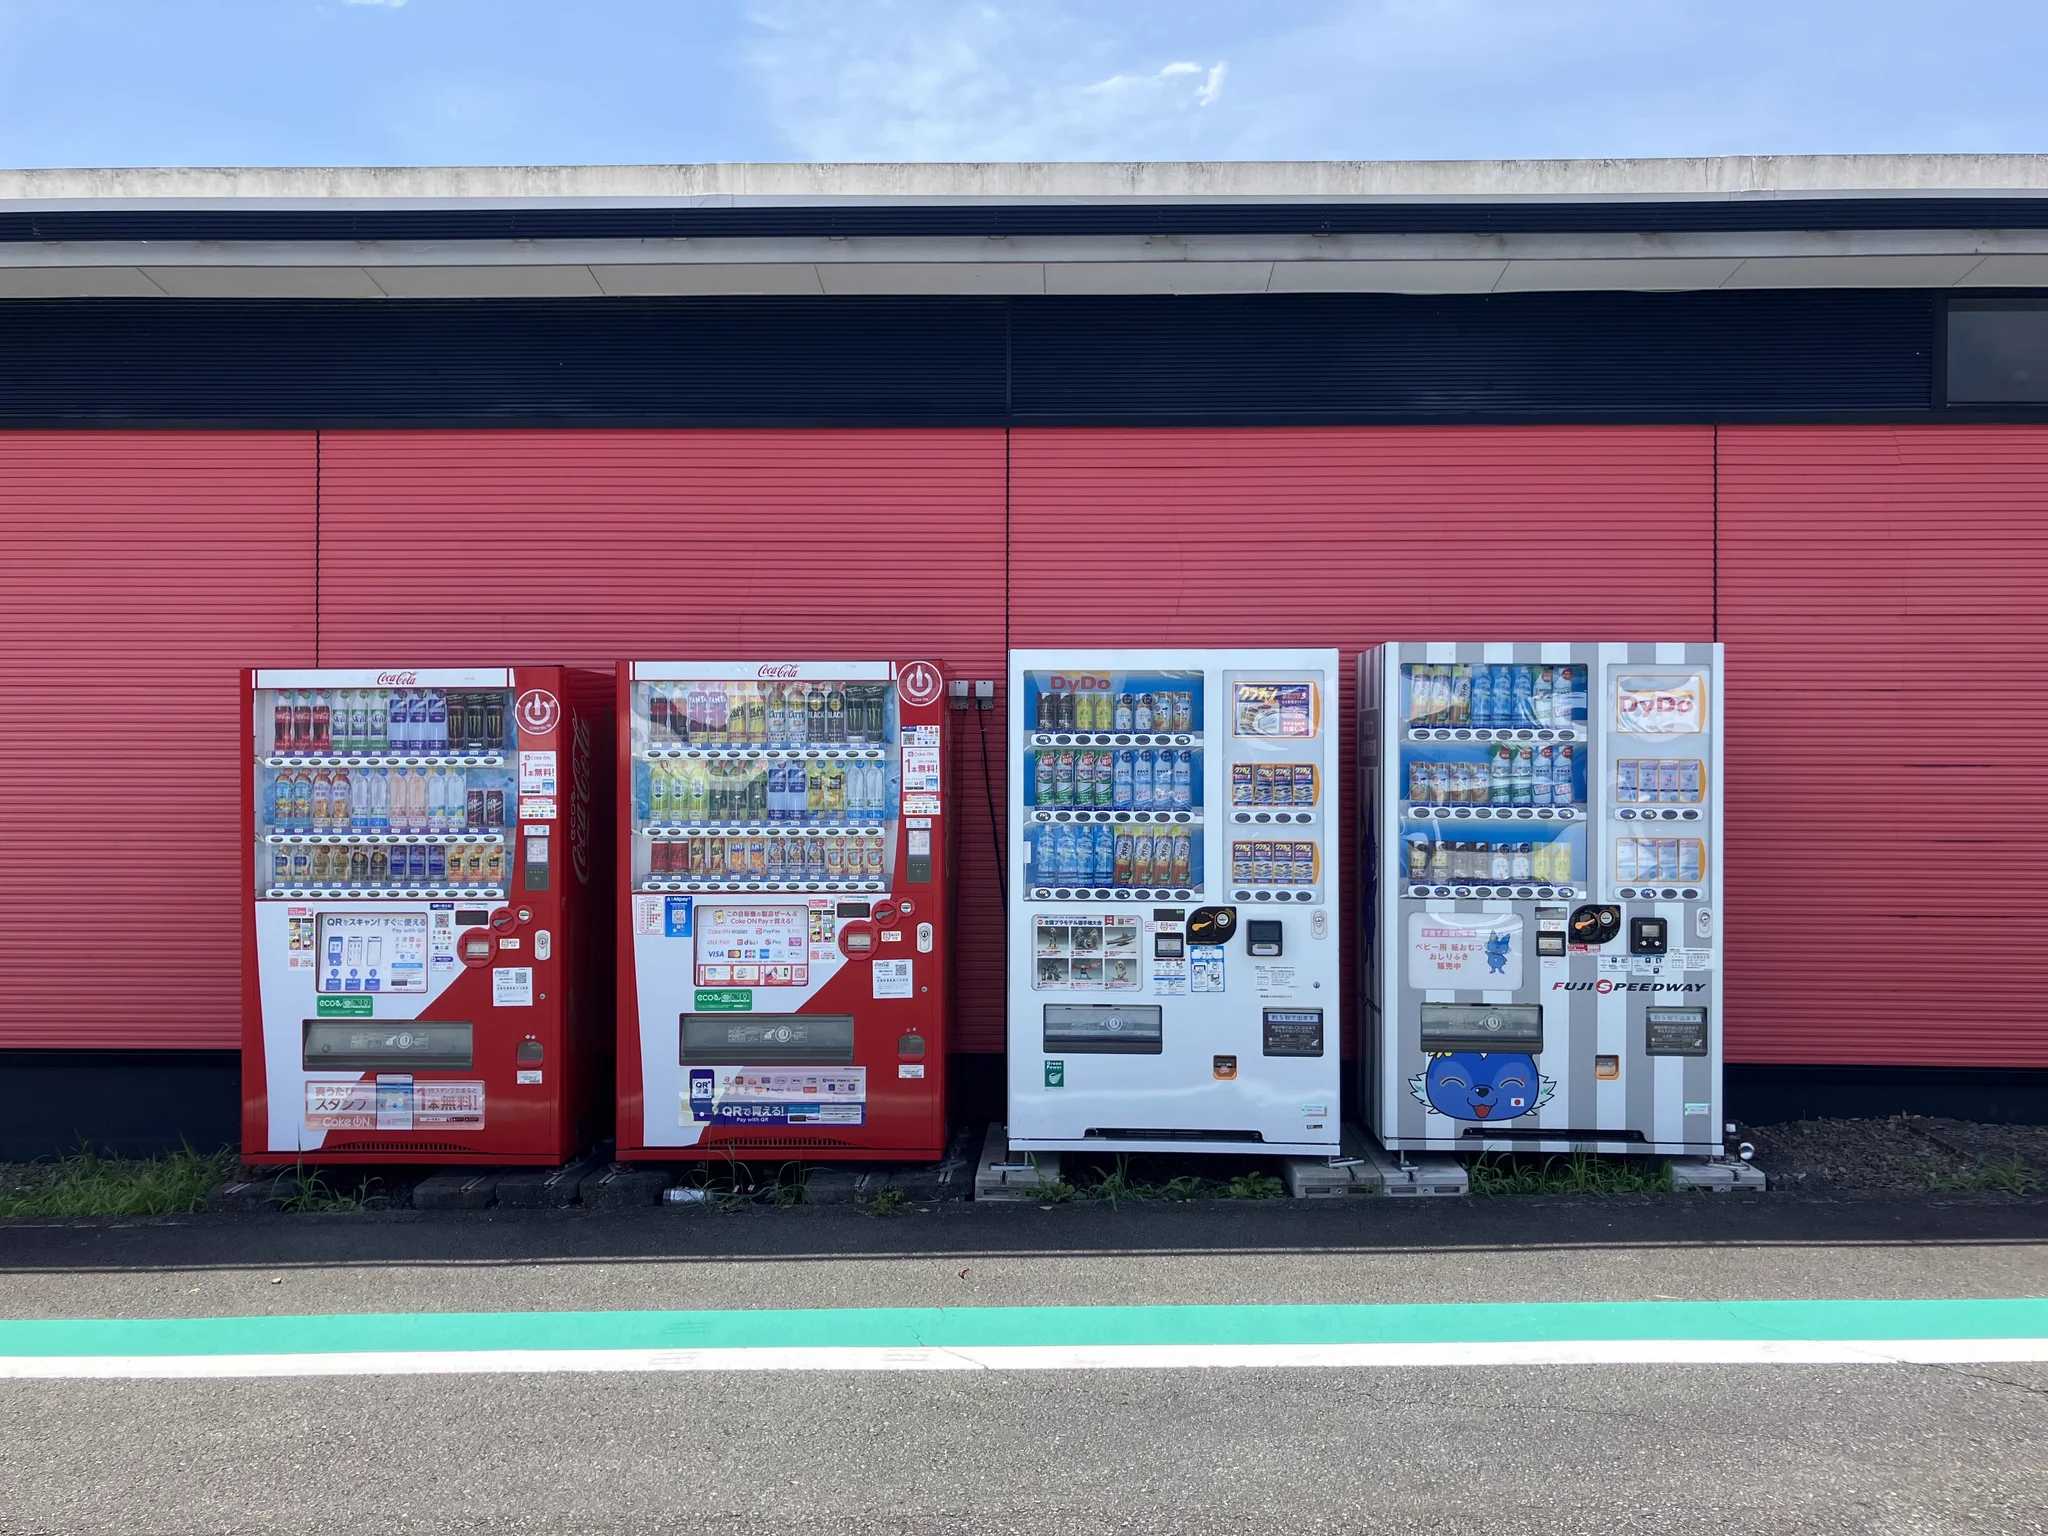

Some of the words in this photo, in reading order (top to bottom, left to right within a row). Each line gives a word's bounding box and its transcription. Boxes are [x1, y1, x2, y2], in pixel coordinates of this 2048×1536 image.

[758, 664, 800, 678] Coca-Cola
[377, 671, 418, 686] Coca-Cola
[1050, 676, 1111, 693] DyDo
[1619, 696, 1693, 717] DyDo
[521, 762, 555, 777] 1本無料!
[904, 758, 938, 773] 1本無料!
[327, 918, 380, 926] QRをスキャン!
[384, 918, 426, 926] すぐに使える
[1415, 943, 1447, 951] ベビー用
[1451, 943, 1483, 951] 紙おむつ
[1437, 962, 1461, 970] 販売中
[1552, 982, 1594, 990] FUJI
[1596, 979, 1706, 994] SPEEDWAY
[315, 1086, 356, 1096] 買うたび
[695, 1081, 708, 1089] QR
[315, 1096, 369, 1111] スタンプ
[417, 1087, 478, 1111] 1本無料!
[722, 1105, 784, 1117] QRで買える!
[323, 1117, 351, 1127] Coke
